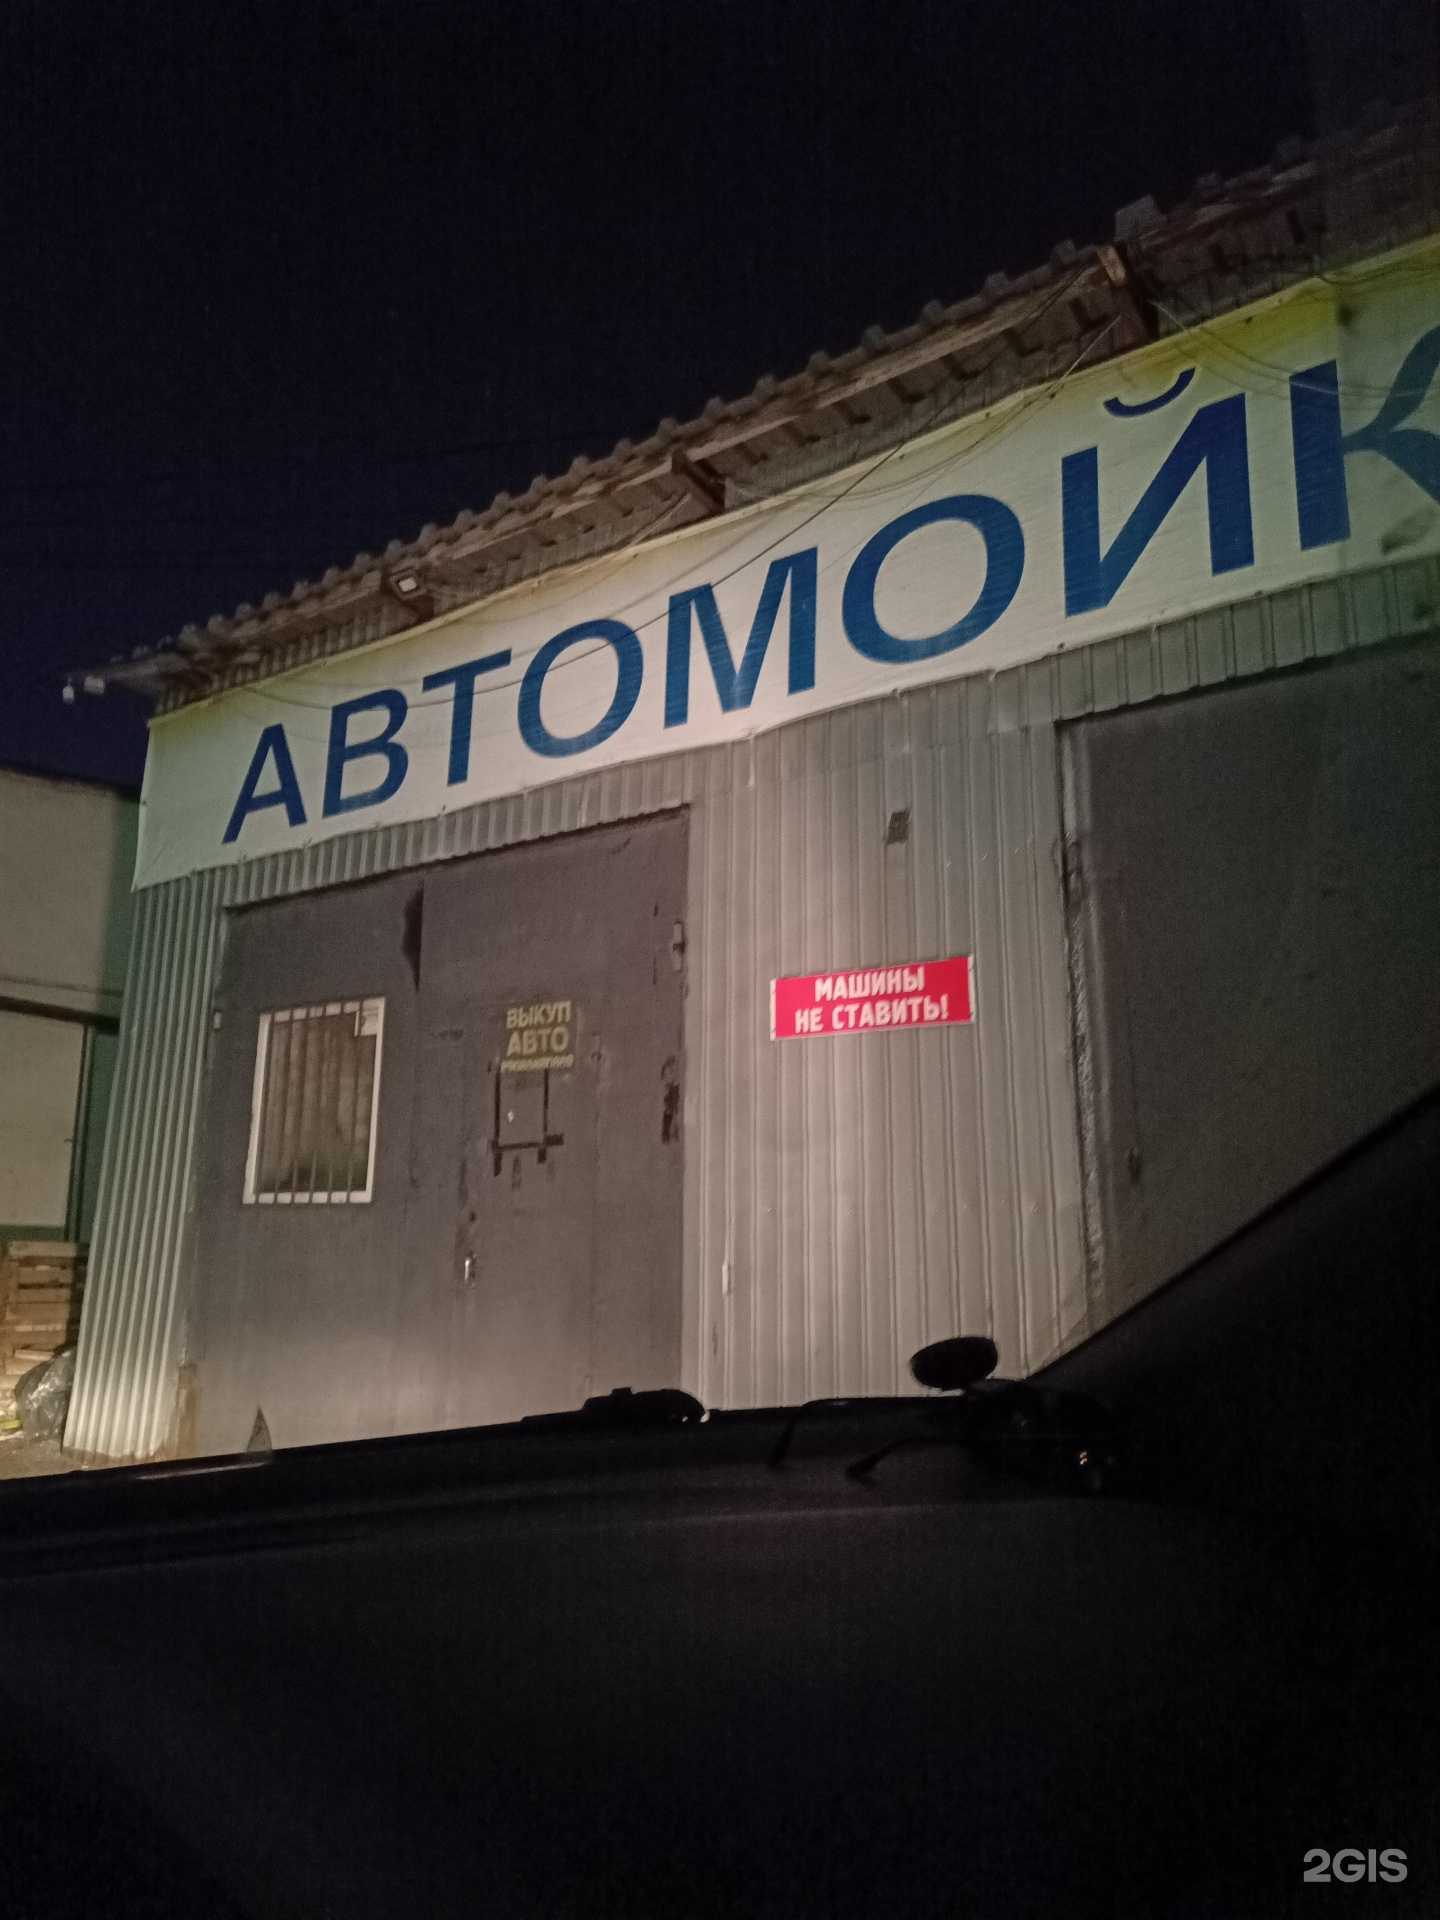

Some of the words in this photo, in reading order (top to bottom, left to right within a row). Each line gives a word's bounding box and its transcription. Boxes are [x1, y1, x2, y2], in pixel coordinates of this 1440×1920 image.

[222, 326, 1440, 844] АВТОМОЙК
[814, 966, 926, 1003] МАШИНЫ
[506, 1001, 571, 1029] ВЫКУП
[795, 1007, 825, 1034] НЕ
[831, 994, 949, 1031] СТАВИТЬ!
[507, 1026, 569, 1057] АВТО
